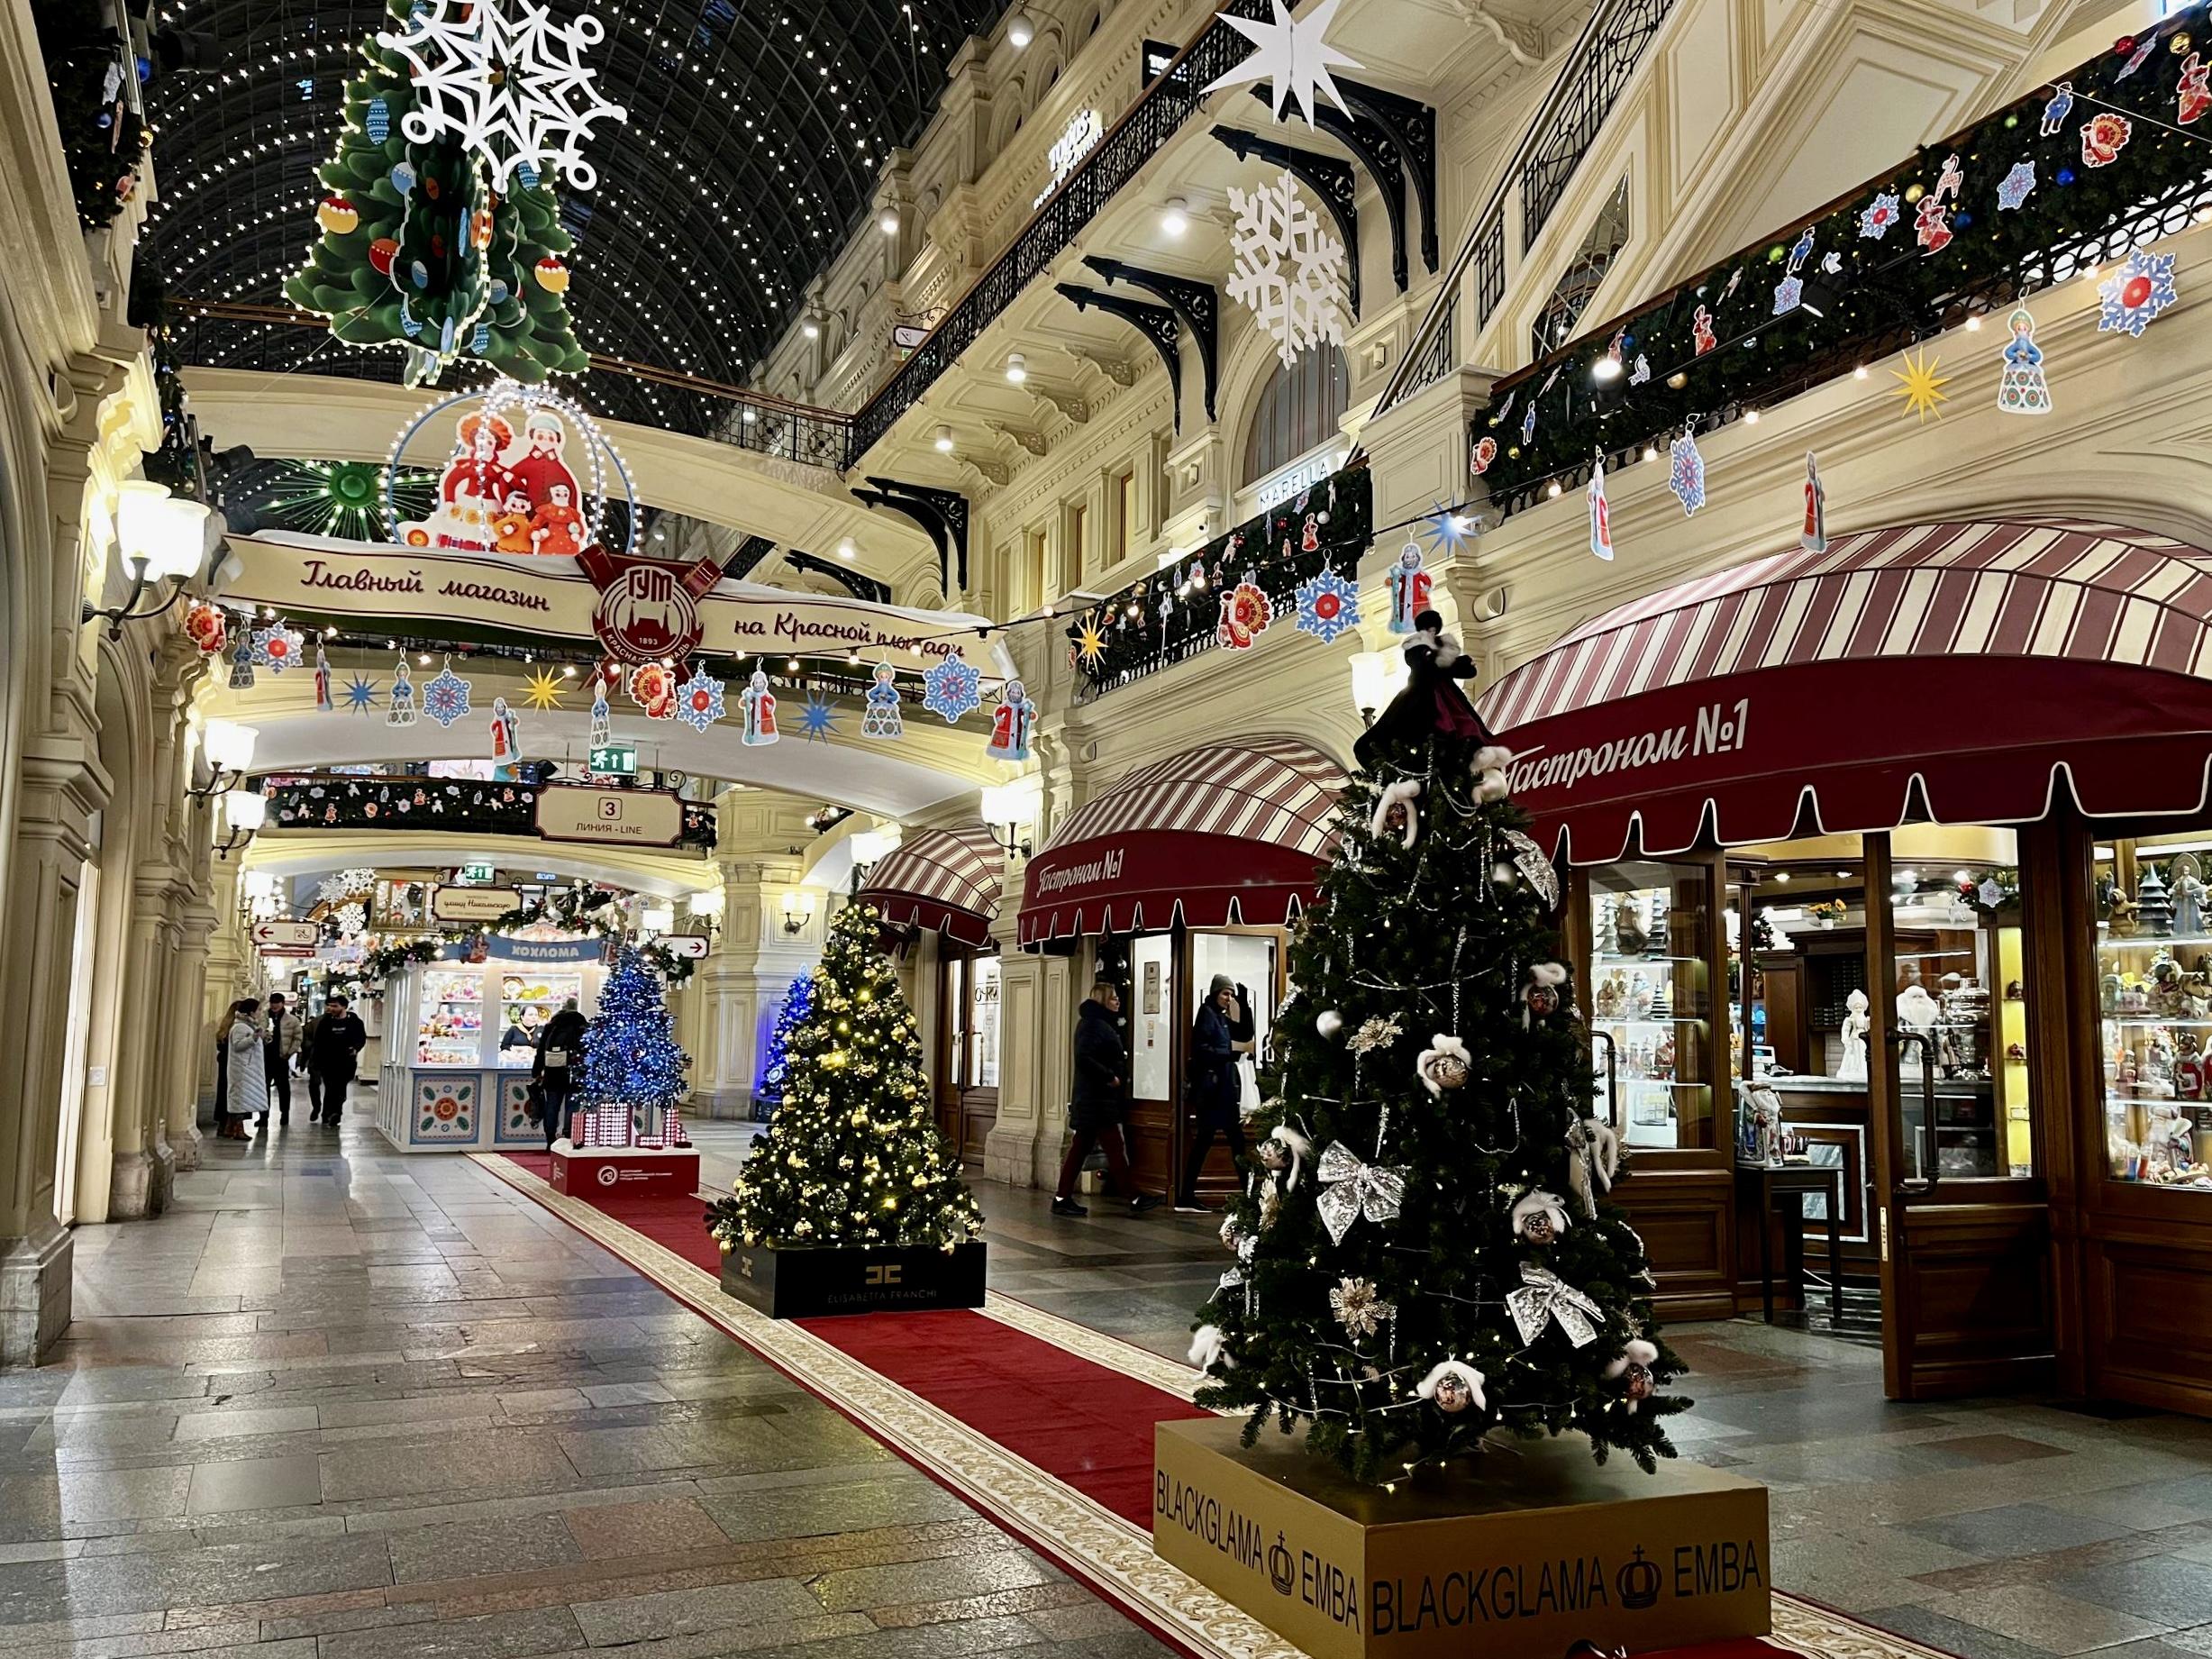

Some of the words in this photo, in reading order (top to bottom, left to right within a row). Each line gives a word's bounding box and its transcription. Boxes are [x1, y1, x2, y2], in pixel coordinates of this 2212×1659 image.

[1260, 461, 1328, 512] MARELLA
[301, 560, 423, 595] Главный
[439, 579, 551, 611] магазин
[629, 569, 672, 602] ГУМ
[639, 637, 658, 645] 1893
[733, 619, 766, 635] на
[774, 613, 872, 644] Красной
[1501, 725, 1689, 798] Гастроном
[1693, 698, 1749, 756] №1
[605, 802, 615, 816] 3
[576, 823, 613, 832] ЛИНИЯ
[621, 825, 642, 834] LINE
[1036, 861, 1103, 898] Гастроном
[1102, 848, 1124, 880] №1
[512, 945, 579, 958] ХОХЛОМА
[827, 1293, 887, 1304] ELISABETTA
[890, 1290, 937, 1299] FRANCHI
[1157, 1470, 1264, 1575] BLACKGLAMA
[1302, 1550, 1361, 1635] EMBA
[1372, 1556, 1608, 1636] BLACKGLAMA
[1673, 1539, 1762, 1598] EMBA
